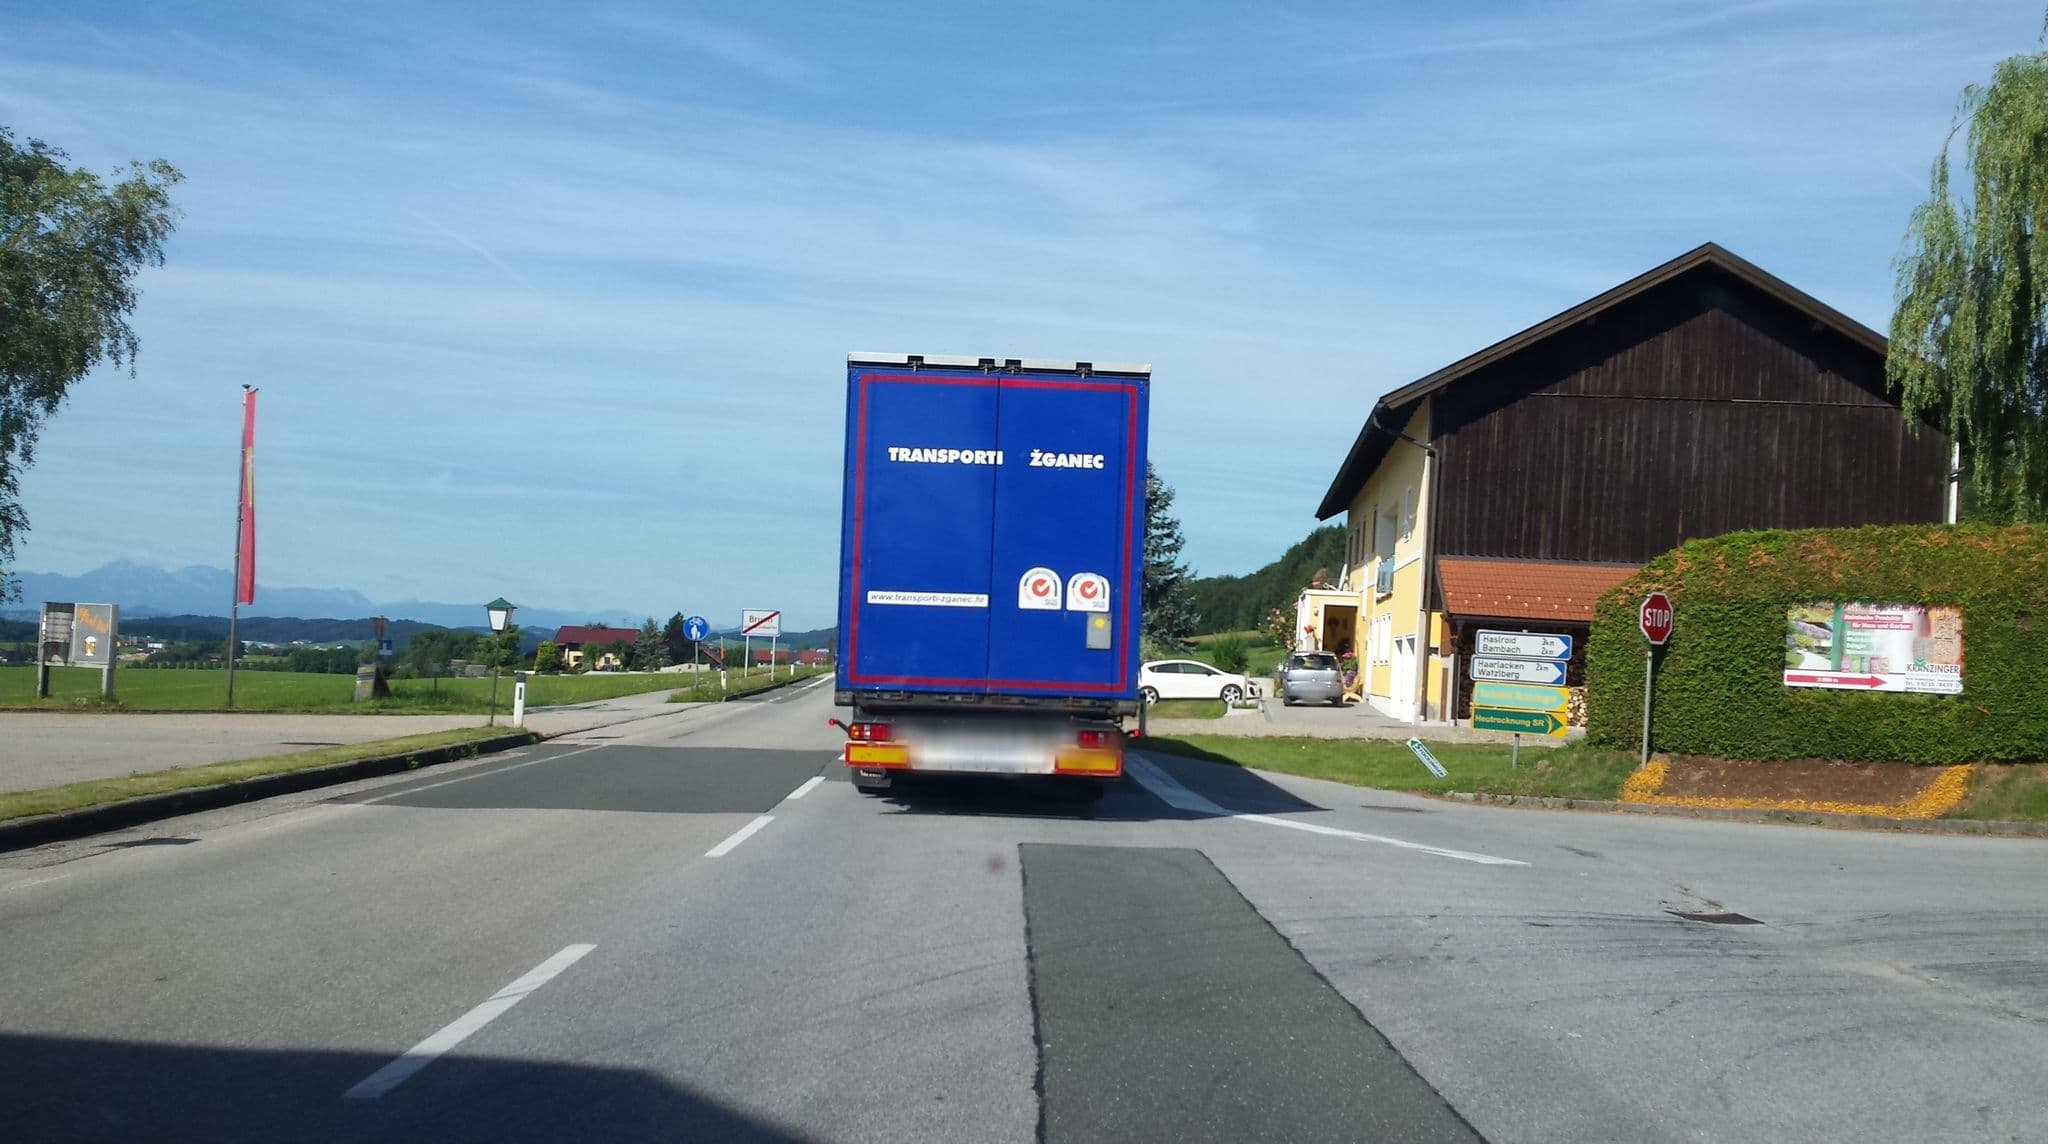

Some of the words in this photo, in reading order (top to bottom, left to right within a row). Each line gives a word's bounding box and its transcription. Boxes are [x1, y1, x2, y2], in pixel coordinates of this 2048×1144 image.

[888, 447, 1003, 465] TRANSPORTI
[1029, 449, 1104, 469] ŽGANEC
[1645, 608, 1670, 628] STOP
[1482, 644, 1520, 653] Bambach
[1478, 661, 1524, 670] Haarlacken
